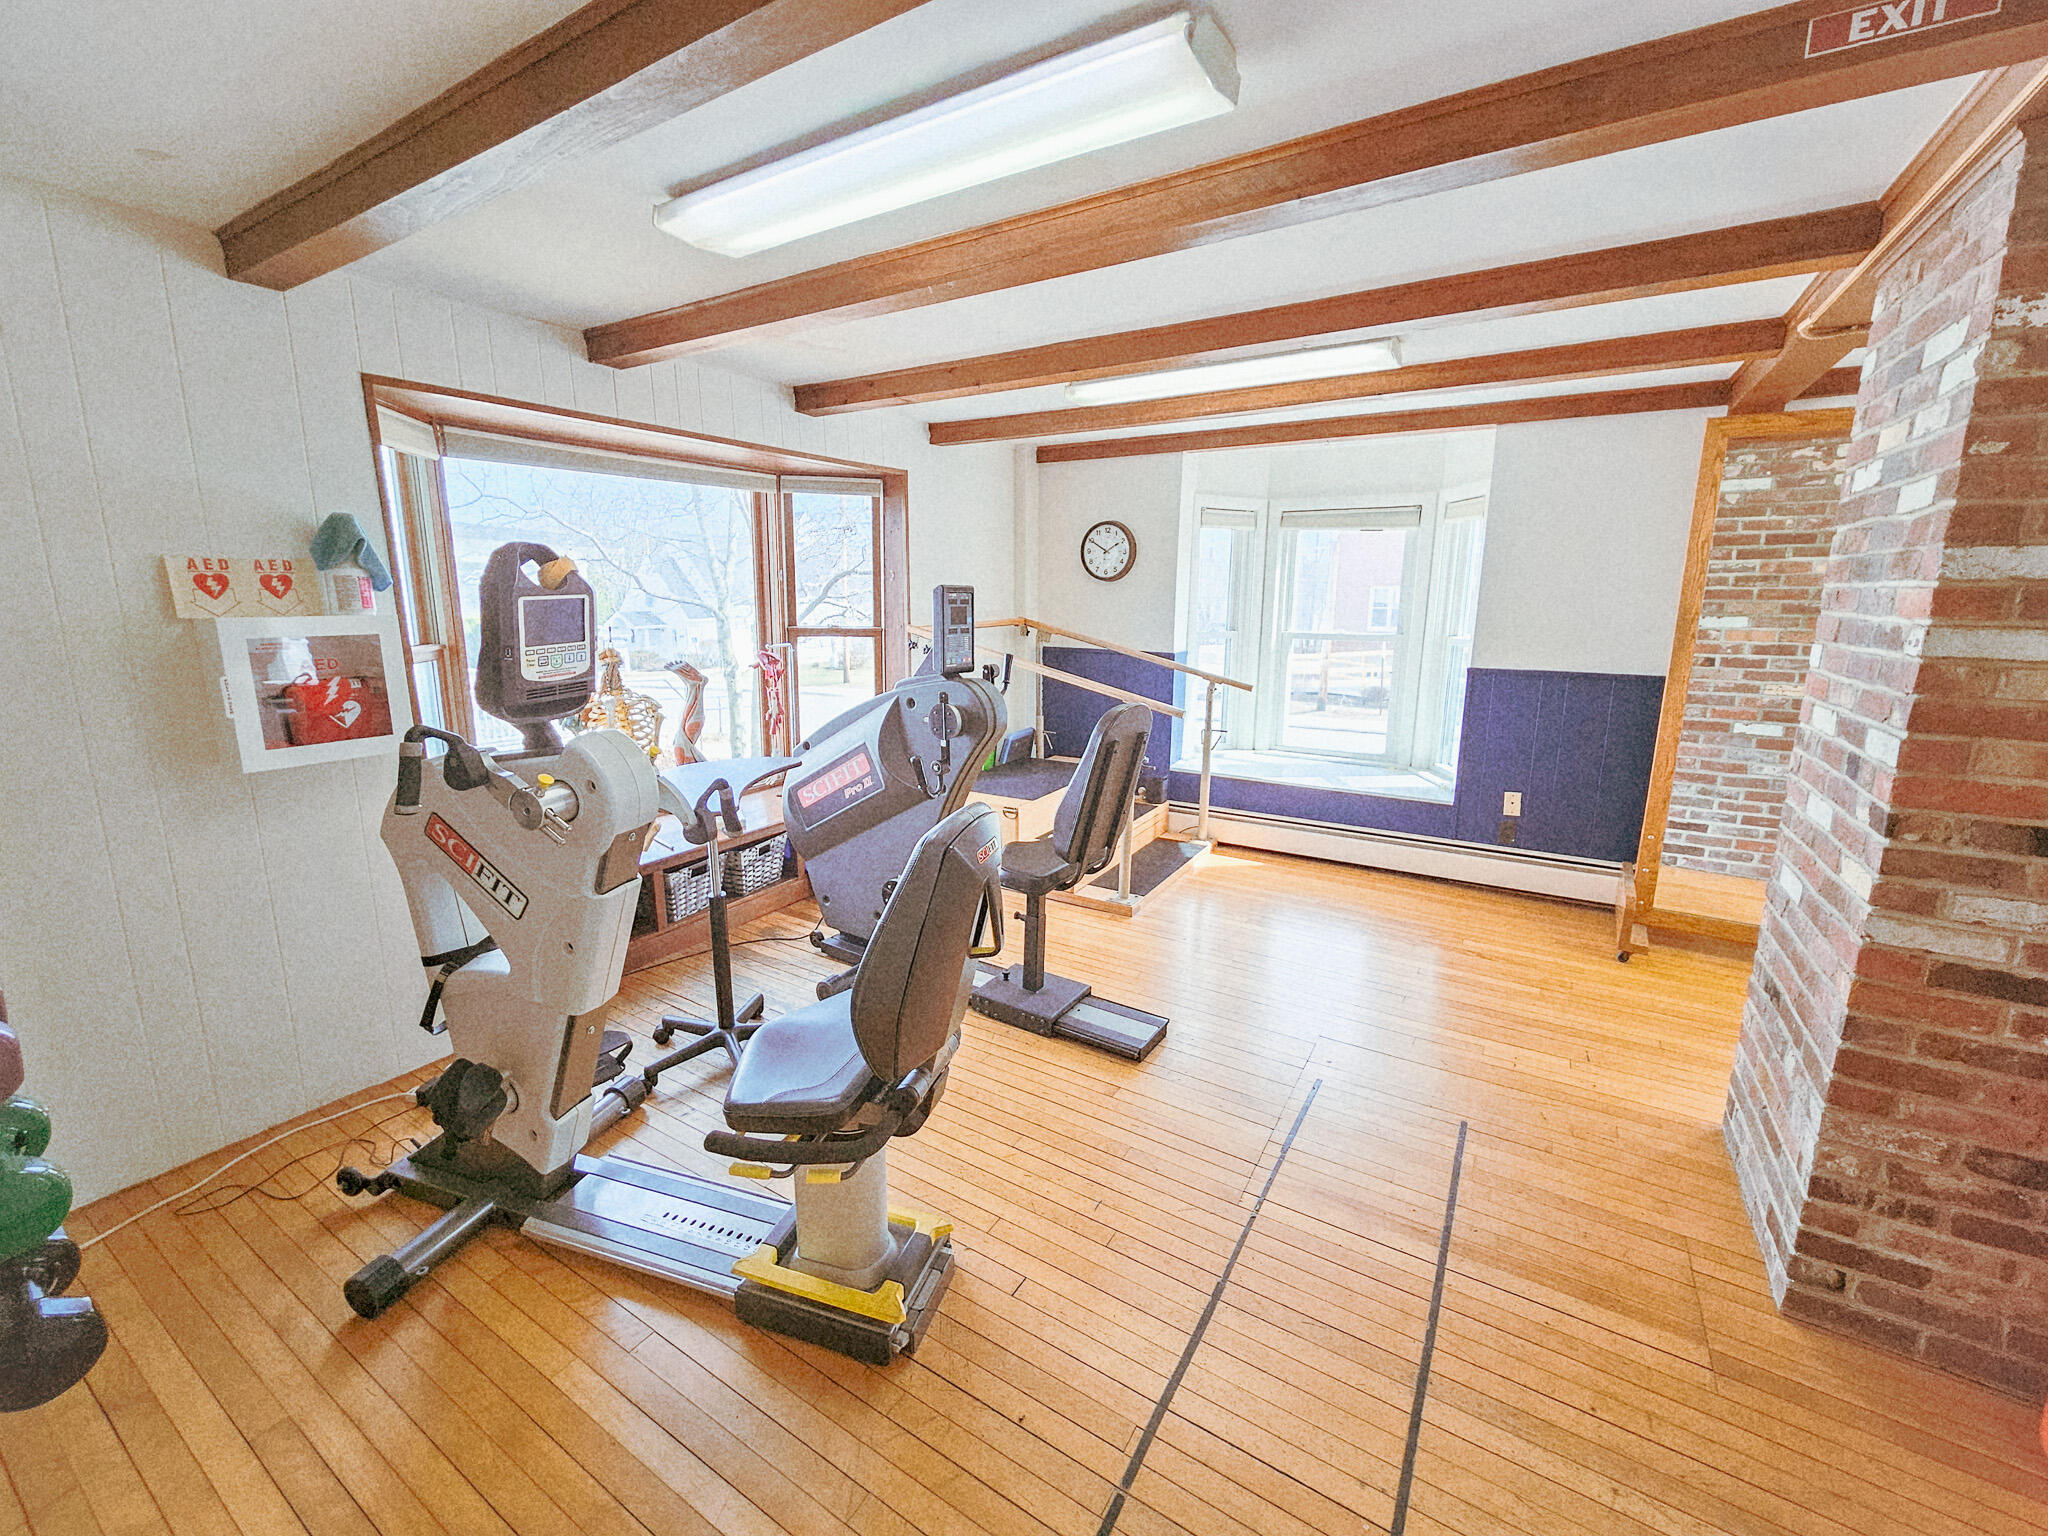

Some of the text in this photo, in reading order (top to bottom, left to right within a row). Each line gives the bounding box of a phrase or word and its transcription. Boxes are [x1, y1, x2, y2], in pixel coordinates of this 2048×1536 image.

[187, 557, 230, 570] AED
[253, 558, 293, 571] AED
[803, 756, 866, 803] SCIFIT
[843, 782, 863, 799] Pro
[431, 823, 522, 906] SCIFIT
